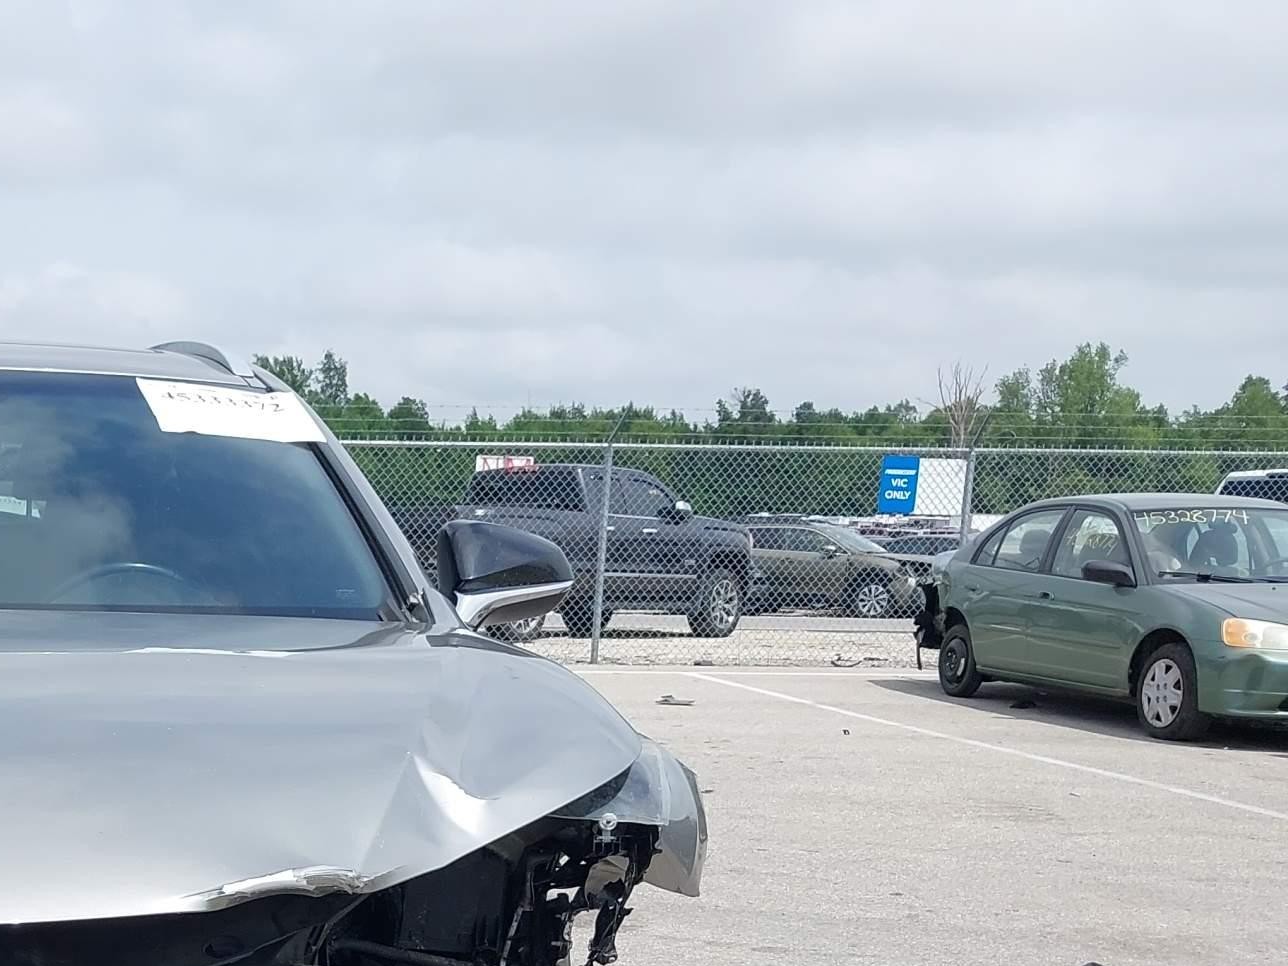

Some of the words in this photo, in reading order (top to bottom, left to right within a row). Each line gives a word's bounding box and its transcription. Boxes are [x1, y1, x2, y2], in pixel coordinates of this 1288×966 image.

[890, 478, 908, 488] VIC
[884, 490, 911, 500] ONLY
[1134, 509, 1249, 527] 45328774
